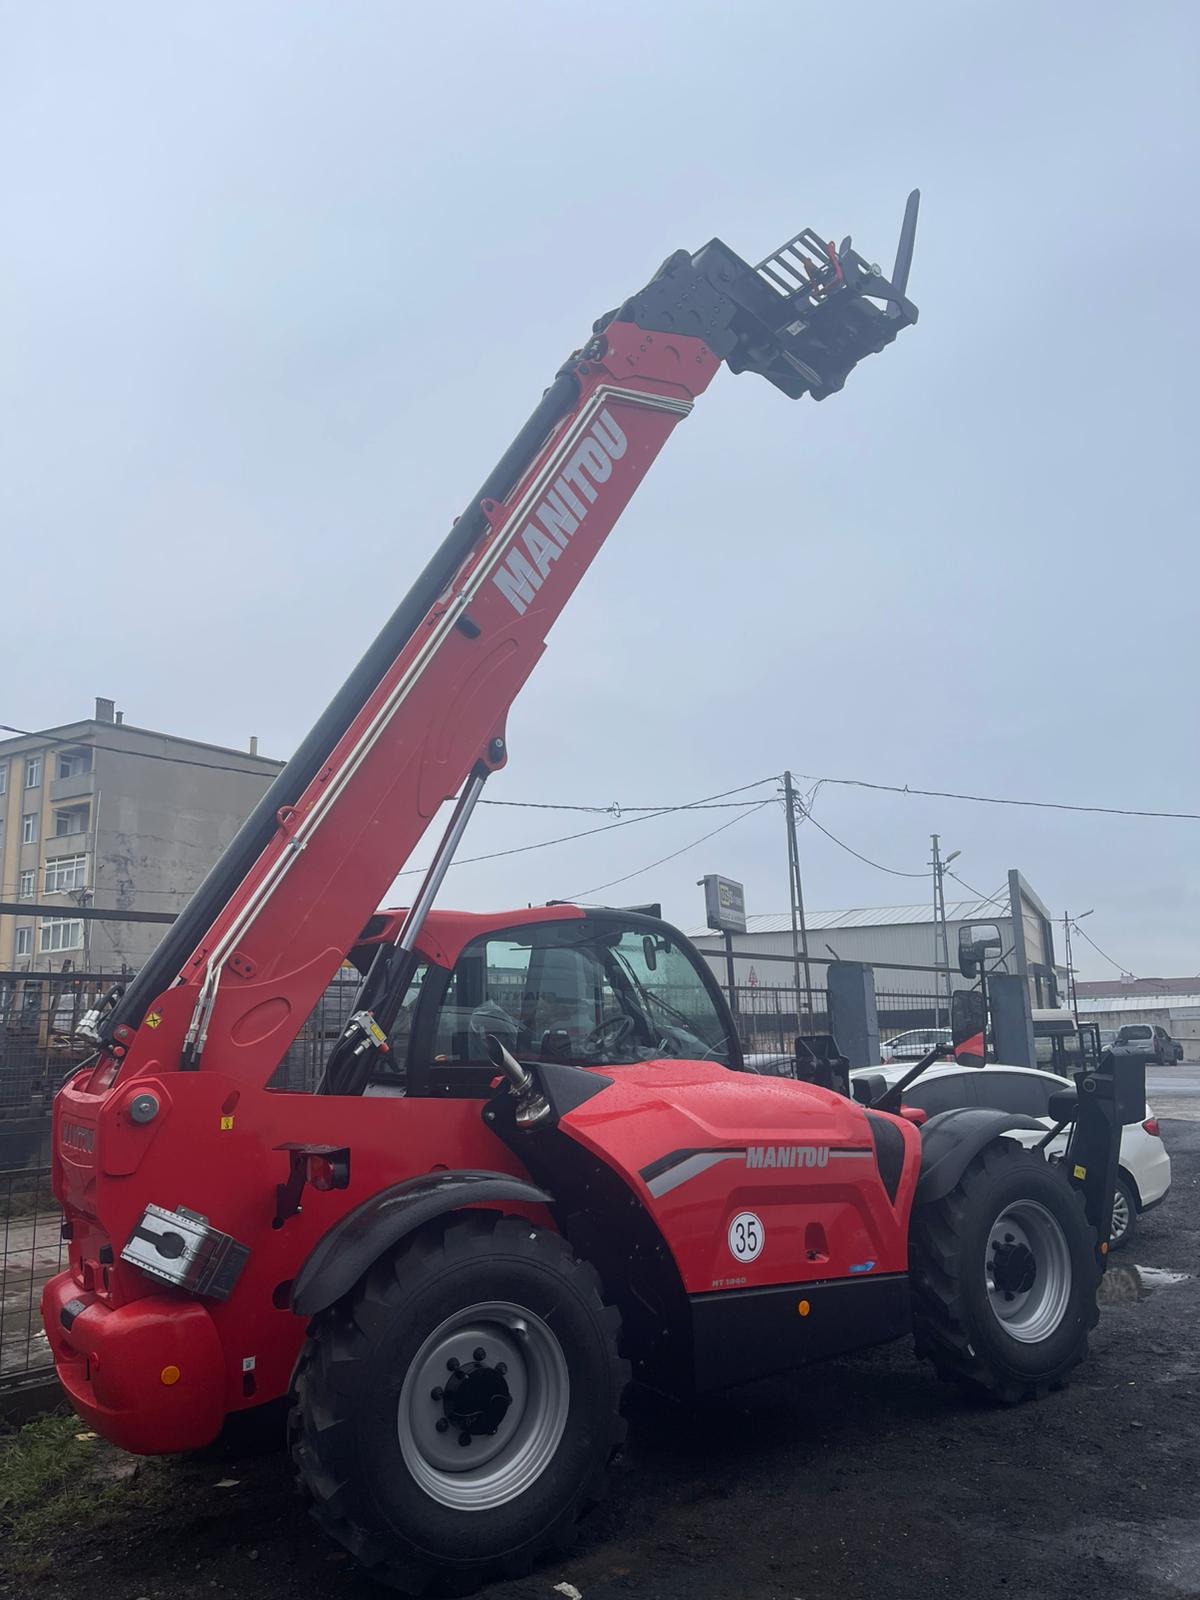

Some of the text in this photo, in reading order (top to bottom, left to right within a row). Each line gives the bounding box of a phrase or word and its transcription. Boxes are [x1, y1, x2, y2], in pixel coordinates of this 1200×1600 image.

[491, 407, 628, 616] MANITOU
[745, 1146, 830, 1169] MANITOU
[735, 1221, 758, 1254] 35
